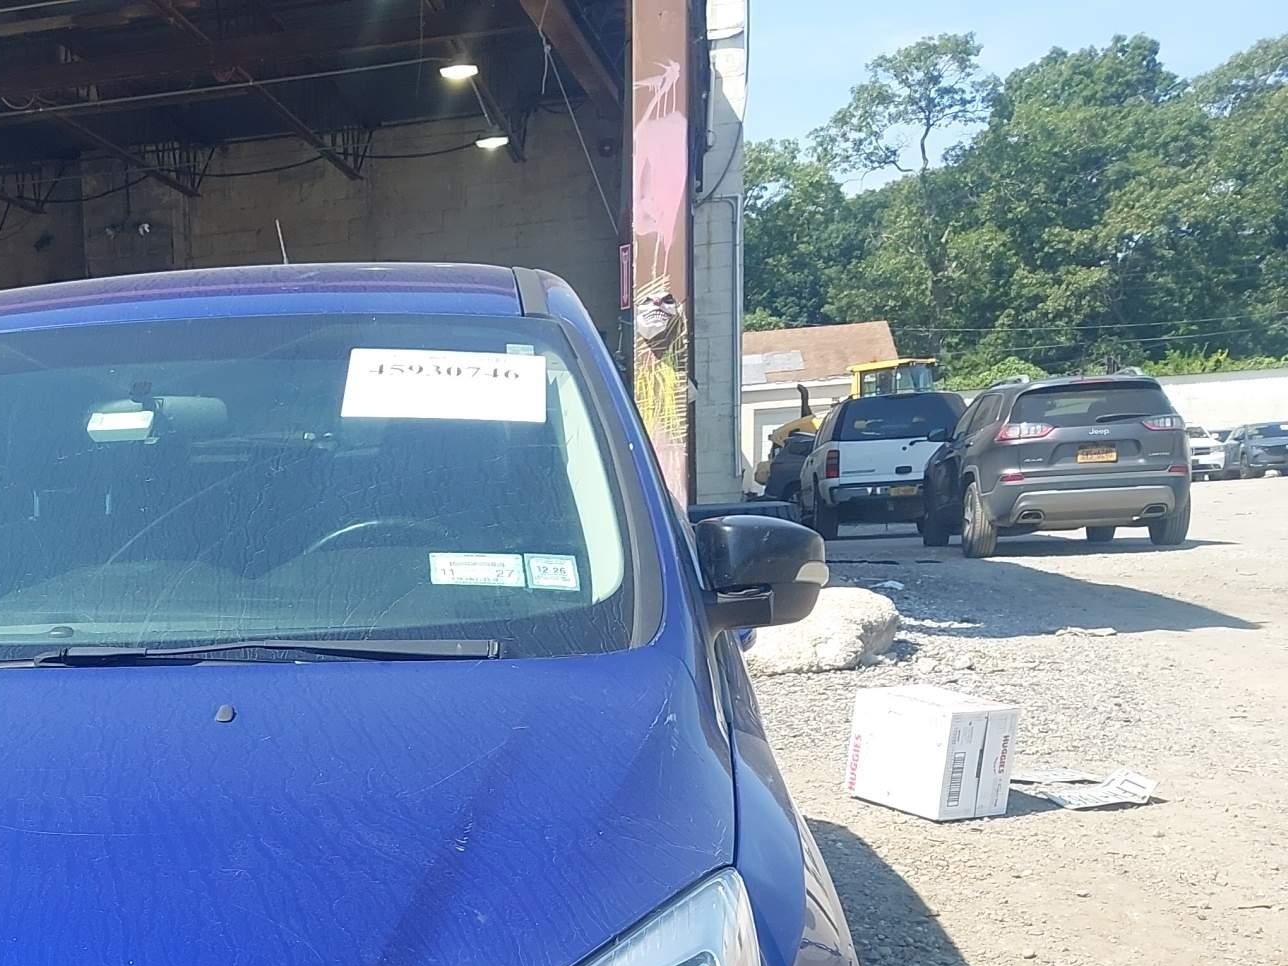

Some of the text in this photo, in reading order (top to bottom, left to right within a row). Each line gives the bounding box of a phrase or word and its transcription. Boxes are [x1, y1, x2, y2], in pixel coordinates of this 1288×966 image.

[369, 363, 520, 379] 45930746
[1088, 427, 1110, 436] Jeep
[848, 734, 862, 791] HUGGIES
[998, 734, 1010, 774] HUGGIES
